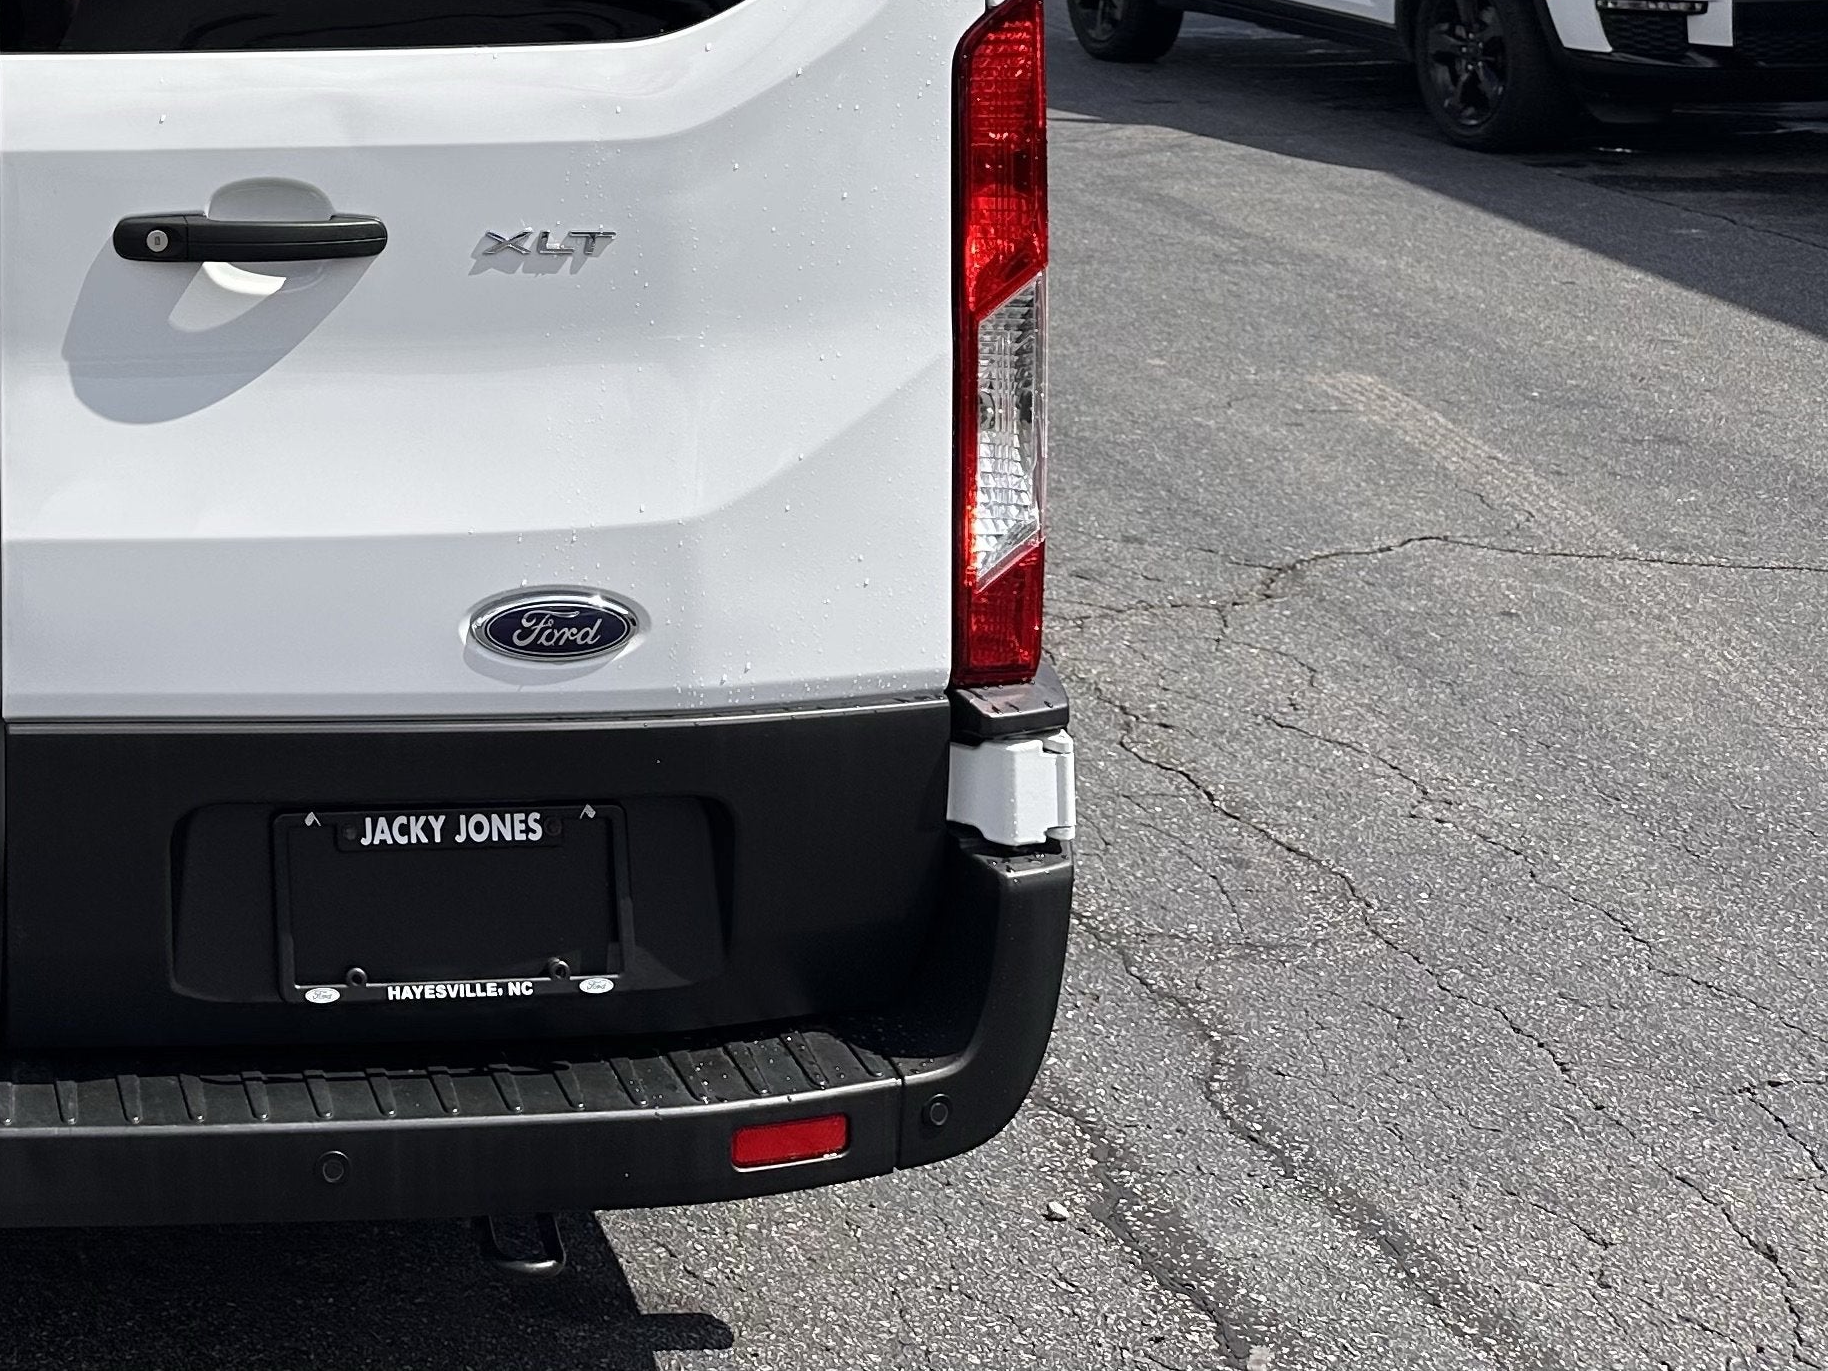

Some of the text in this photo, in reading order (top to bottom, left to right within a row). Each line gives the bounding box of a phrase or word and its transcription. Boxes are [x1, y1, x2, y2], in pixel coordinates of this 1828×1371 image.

[482, 229, 617, 254] XLT
[512, 609, 603, 647] Ford
[360, 812, 543, 846] JACKY JONES
[387, 981, 534, 1000] HAYESVILLE, NC
